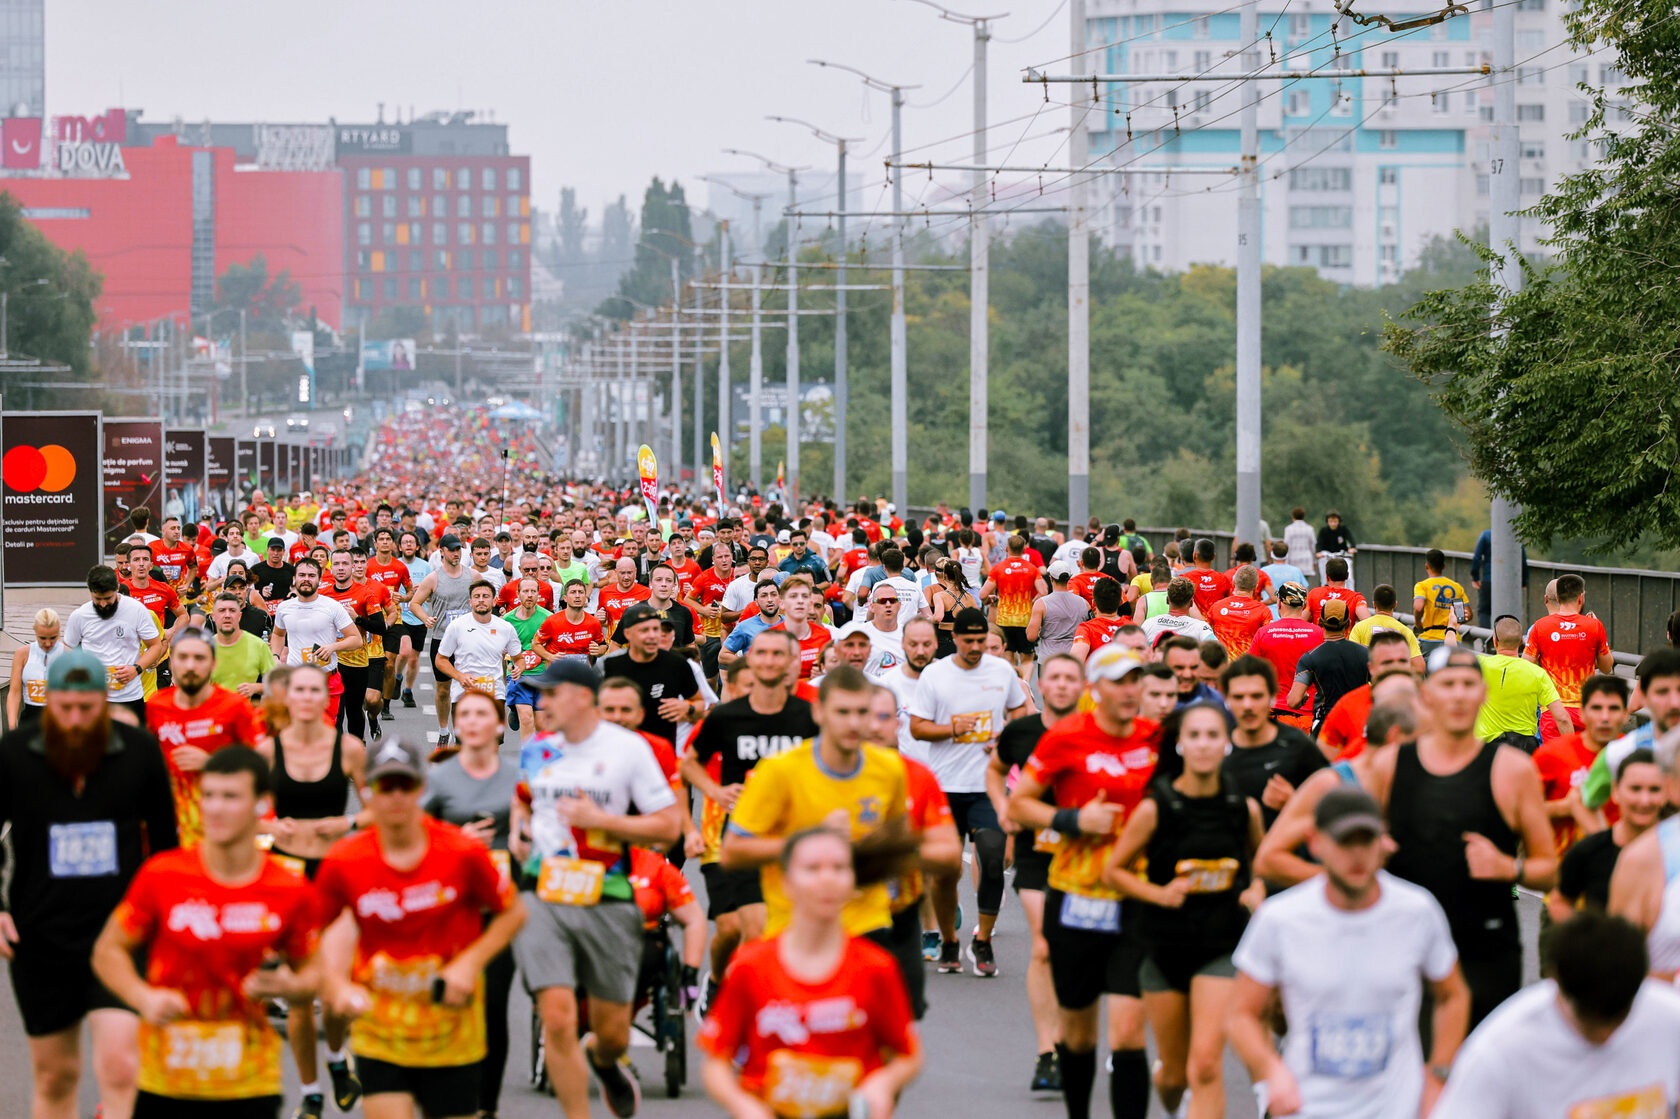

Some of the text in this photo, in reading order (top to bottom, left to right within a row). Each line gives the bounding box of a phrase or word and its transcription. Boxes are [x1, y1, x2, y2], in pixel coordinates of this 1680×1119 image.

[59, 142, 126, 172] DOVA
[121, 436, 153, 445] ENIGMA
[127, 458, 154, 467] parfum
[5, 493, 73, 504] mastercard
[25, 519, 46, 528] pentru
